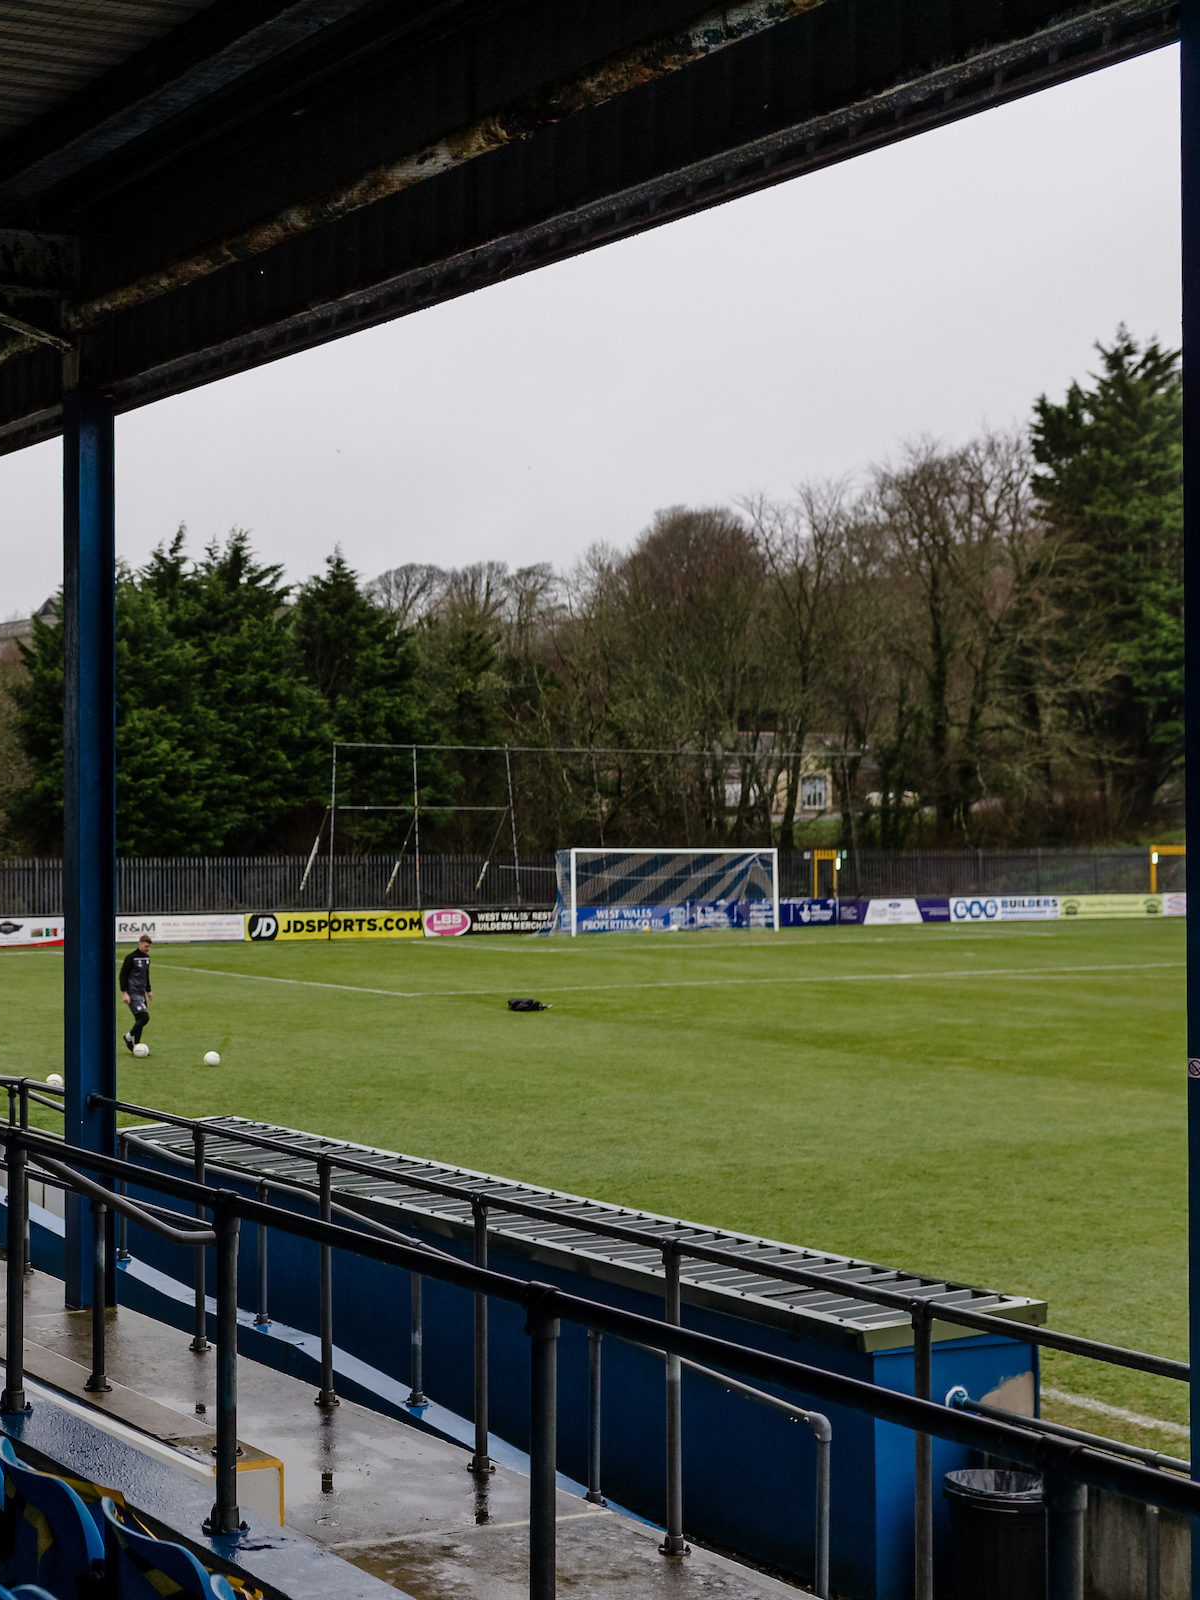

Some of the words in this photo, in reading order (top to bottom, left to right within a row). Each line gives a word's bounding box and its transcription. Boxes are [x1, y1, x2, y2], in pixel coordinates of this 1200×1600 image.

[1001, 899, 1058, 908] BUILDERS
[477, 912, 499, 921] WEST
[532, 911, 552, 920] BEST
[596, 909, 620, 919] WEST
[622, 908, 653, 918] WALES
[432, 914, 462, 924] LBS
[118, 922, 156, 932] R&M
[251, 917, 276, 938] JD
[282, 917, 423, 933] JDSPORTS.COM
[472, 922, 512, 931] BUILDERS
